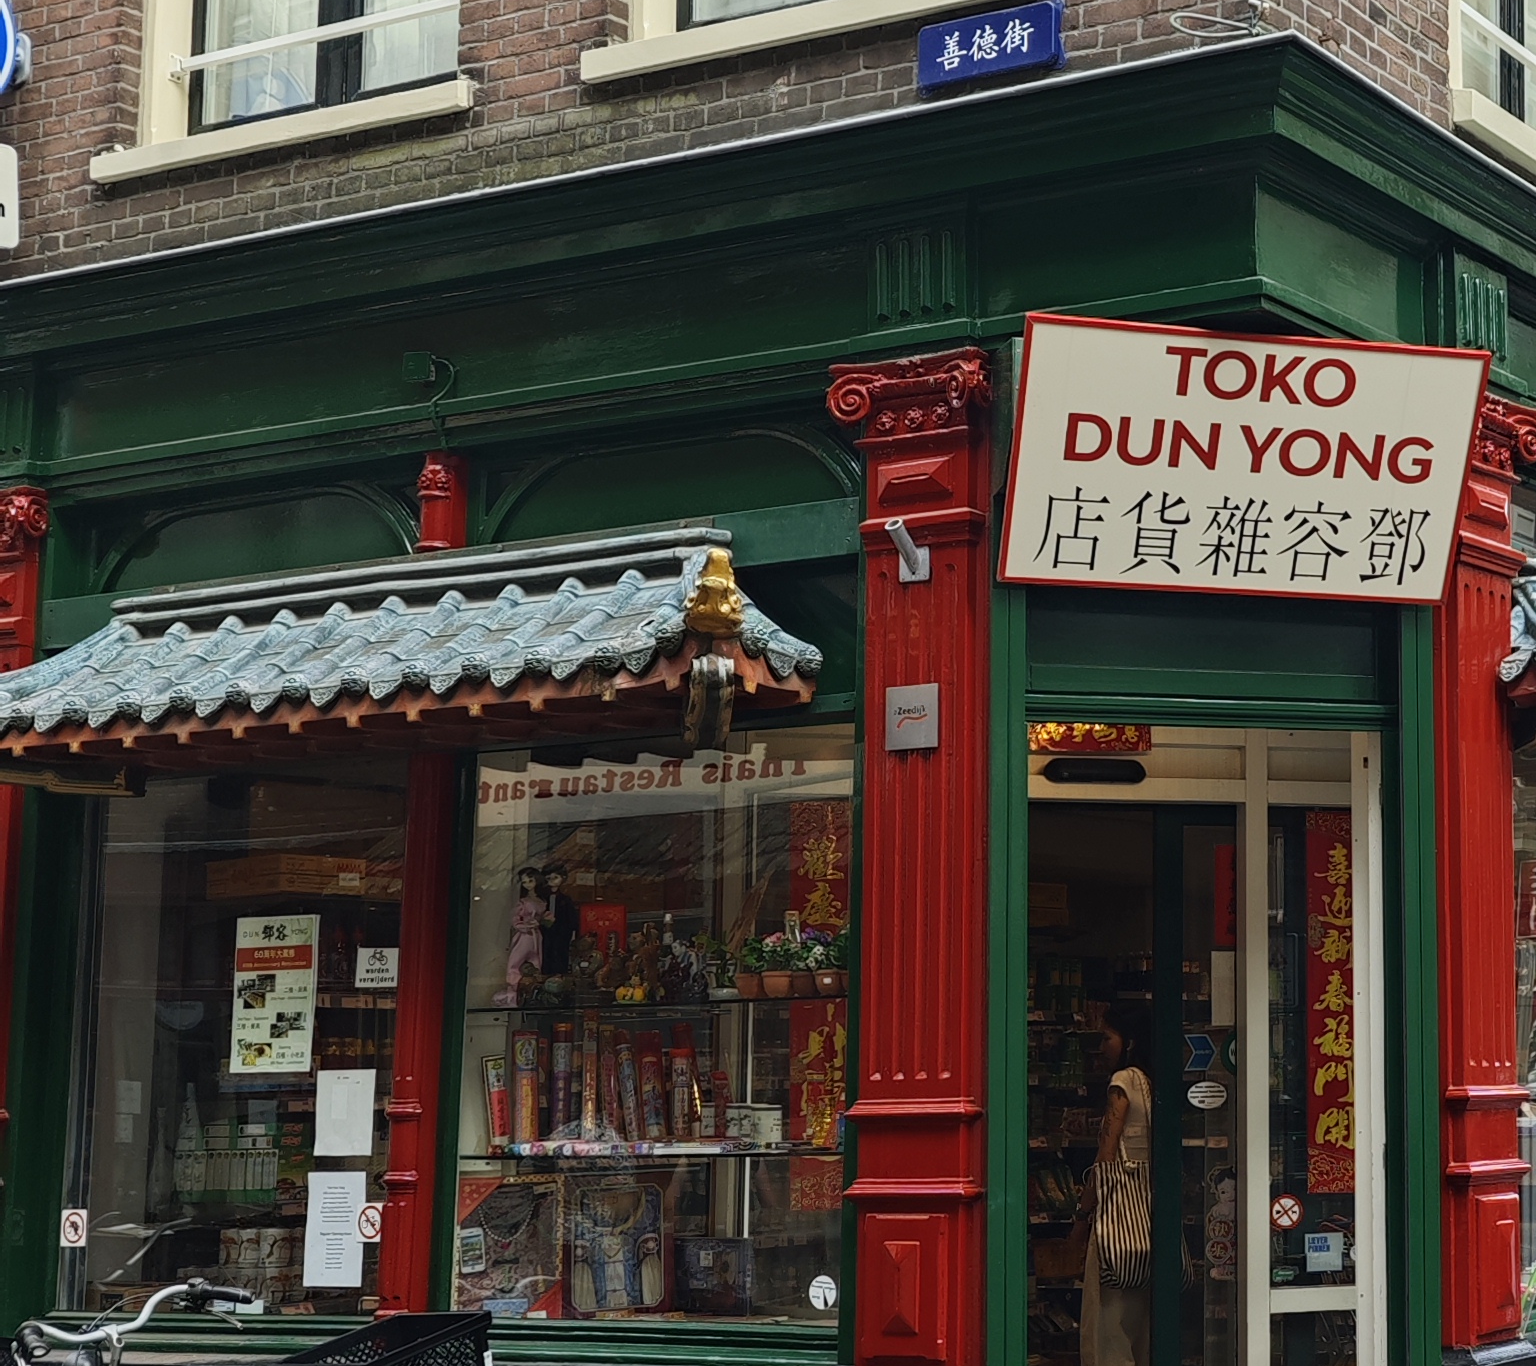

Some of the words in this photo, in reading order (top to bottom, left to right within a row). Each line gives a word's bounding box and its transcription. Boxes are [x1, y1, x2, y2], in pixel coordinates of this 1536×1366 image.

[936, 18, 1035, 71] 善德街
[1165, 345, 1357, 408] TOKO
[1063, 412, 1222, 471] DUN
[1239, 424, 1434, 485] YONG
[1032, 485, 1432, 586] 店貨雜容鄧
[359, 976, 394, 984] verwijderd
